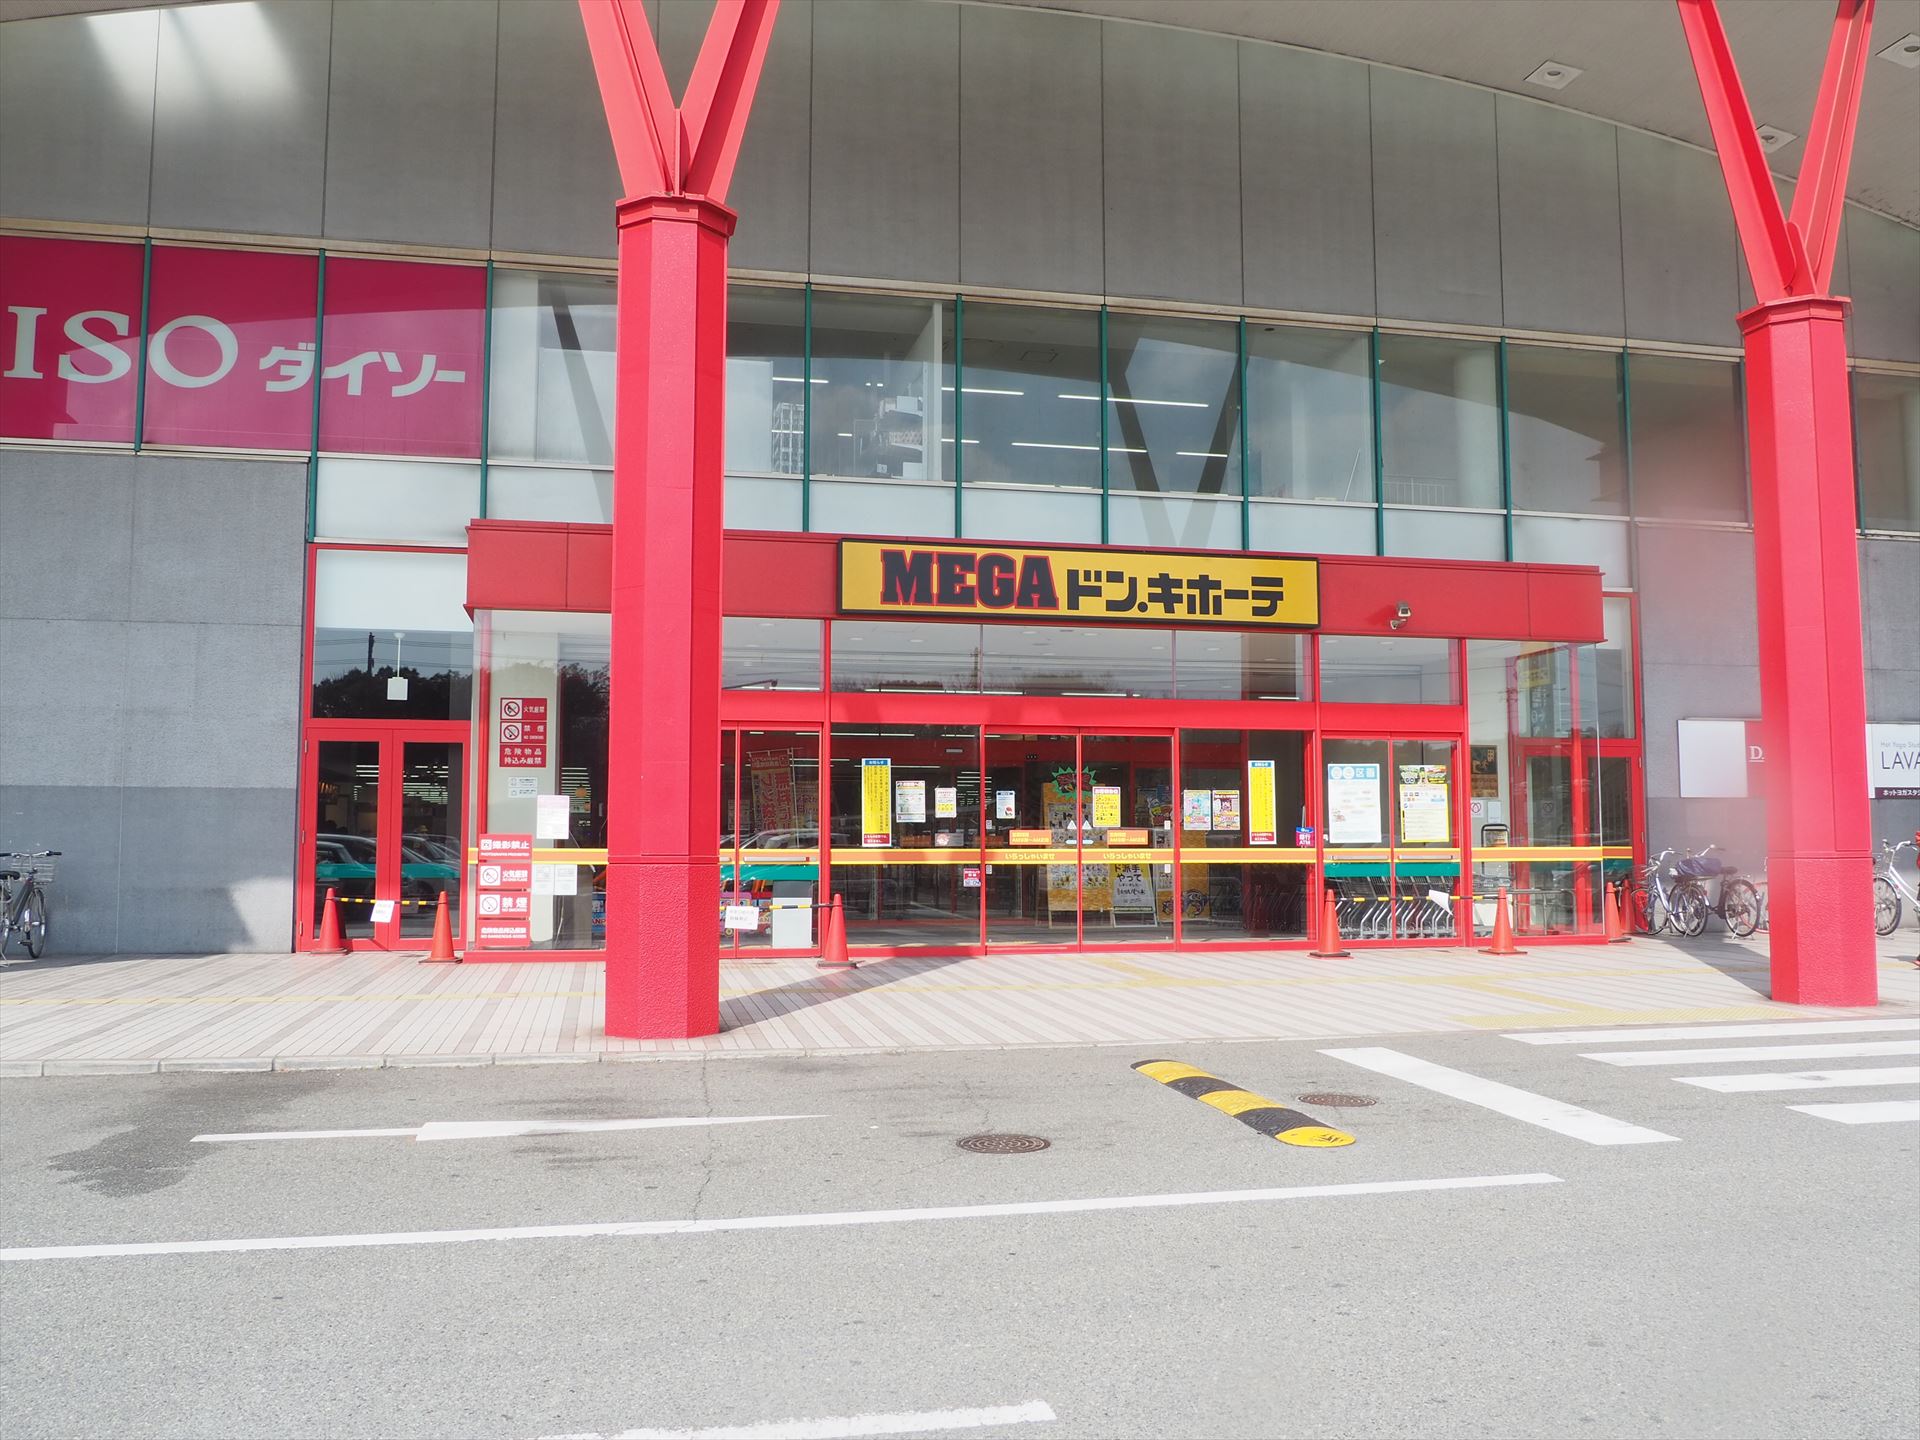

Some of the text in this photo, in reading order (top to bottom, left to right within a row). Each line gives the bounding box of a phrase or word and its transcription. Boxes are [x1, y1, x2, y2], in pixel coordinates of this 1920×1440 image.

[3, 305, 466, 398] ISO ダイソー
[880, 549, 1059, 610] MEGA
[492, 840, 529, 850] 撮影禁止
[1117, 873, 1142, 882] やって
